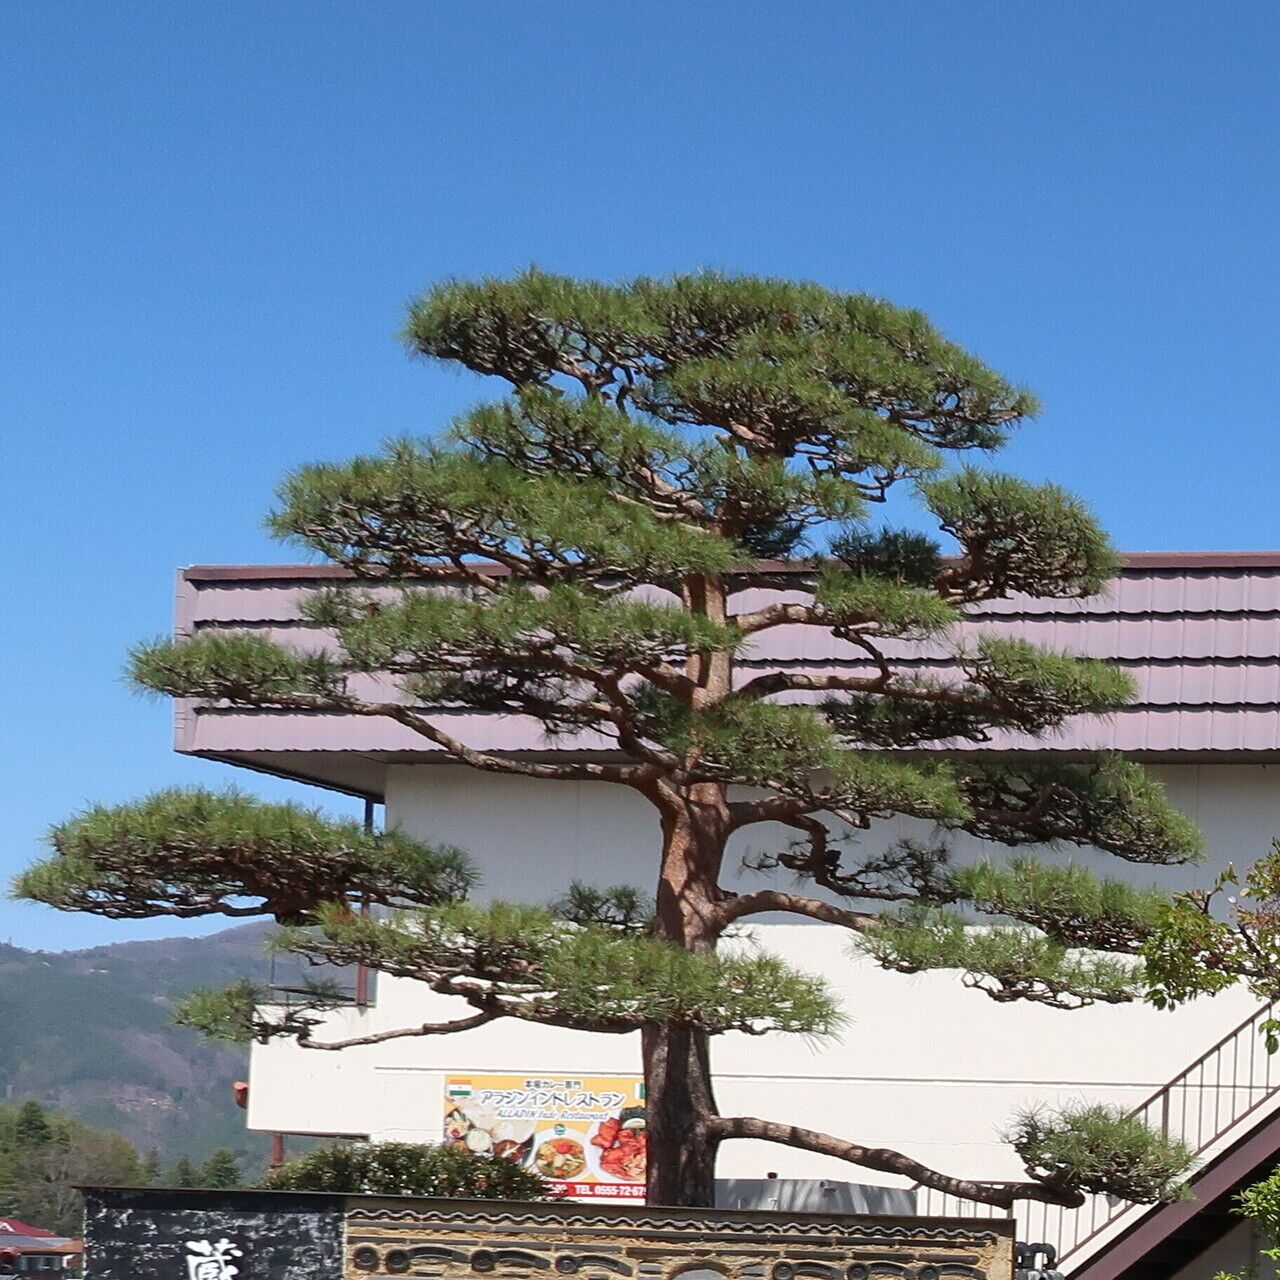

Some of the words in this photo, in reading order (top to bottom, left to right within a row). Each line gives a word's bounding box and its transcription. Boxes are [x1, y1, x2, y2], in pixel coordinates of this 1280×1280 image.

[481, 1091, 625, 1106] アラジンインドレストラン
[575, 1185, 592, 1194] TEL
